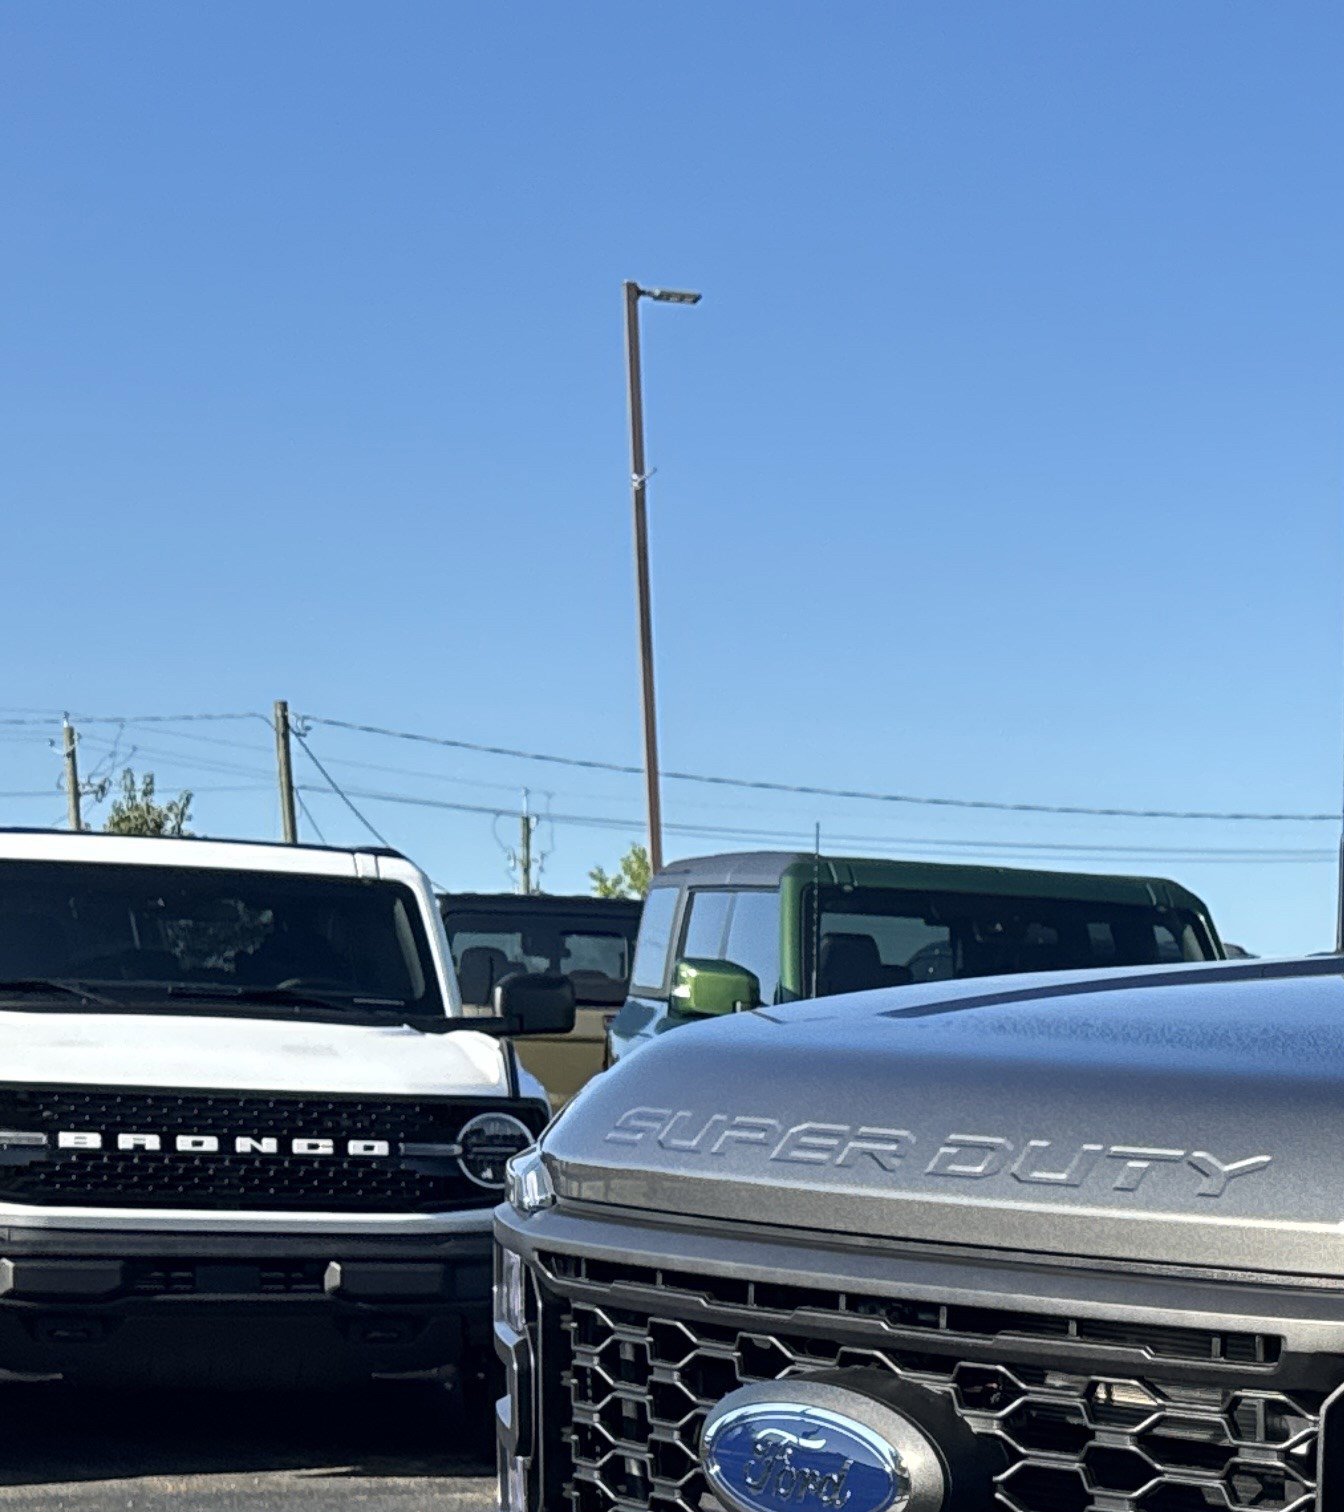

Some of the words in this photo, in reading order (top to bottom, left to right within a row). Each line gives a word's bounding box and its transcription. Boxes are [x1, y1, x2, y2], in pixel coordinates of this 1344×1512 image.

[57, 1131, 390, 1156] BRONCO
[603, 1106, 918, 1173] SUPER
[924, 1133, 1273, 1199] DUTY
[743, 1427, 855, 1510] Ford
